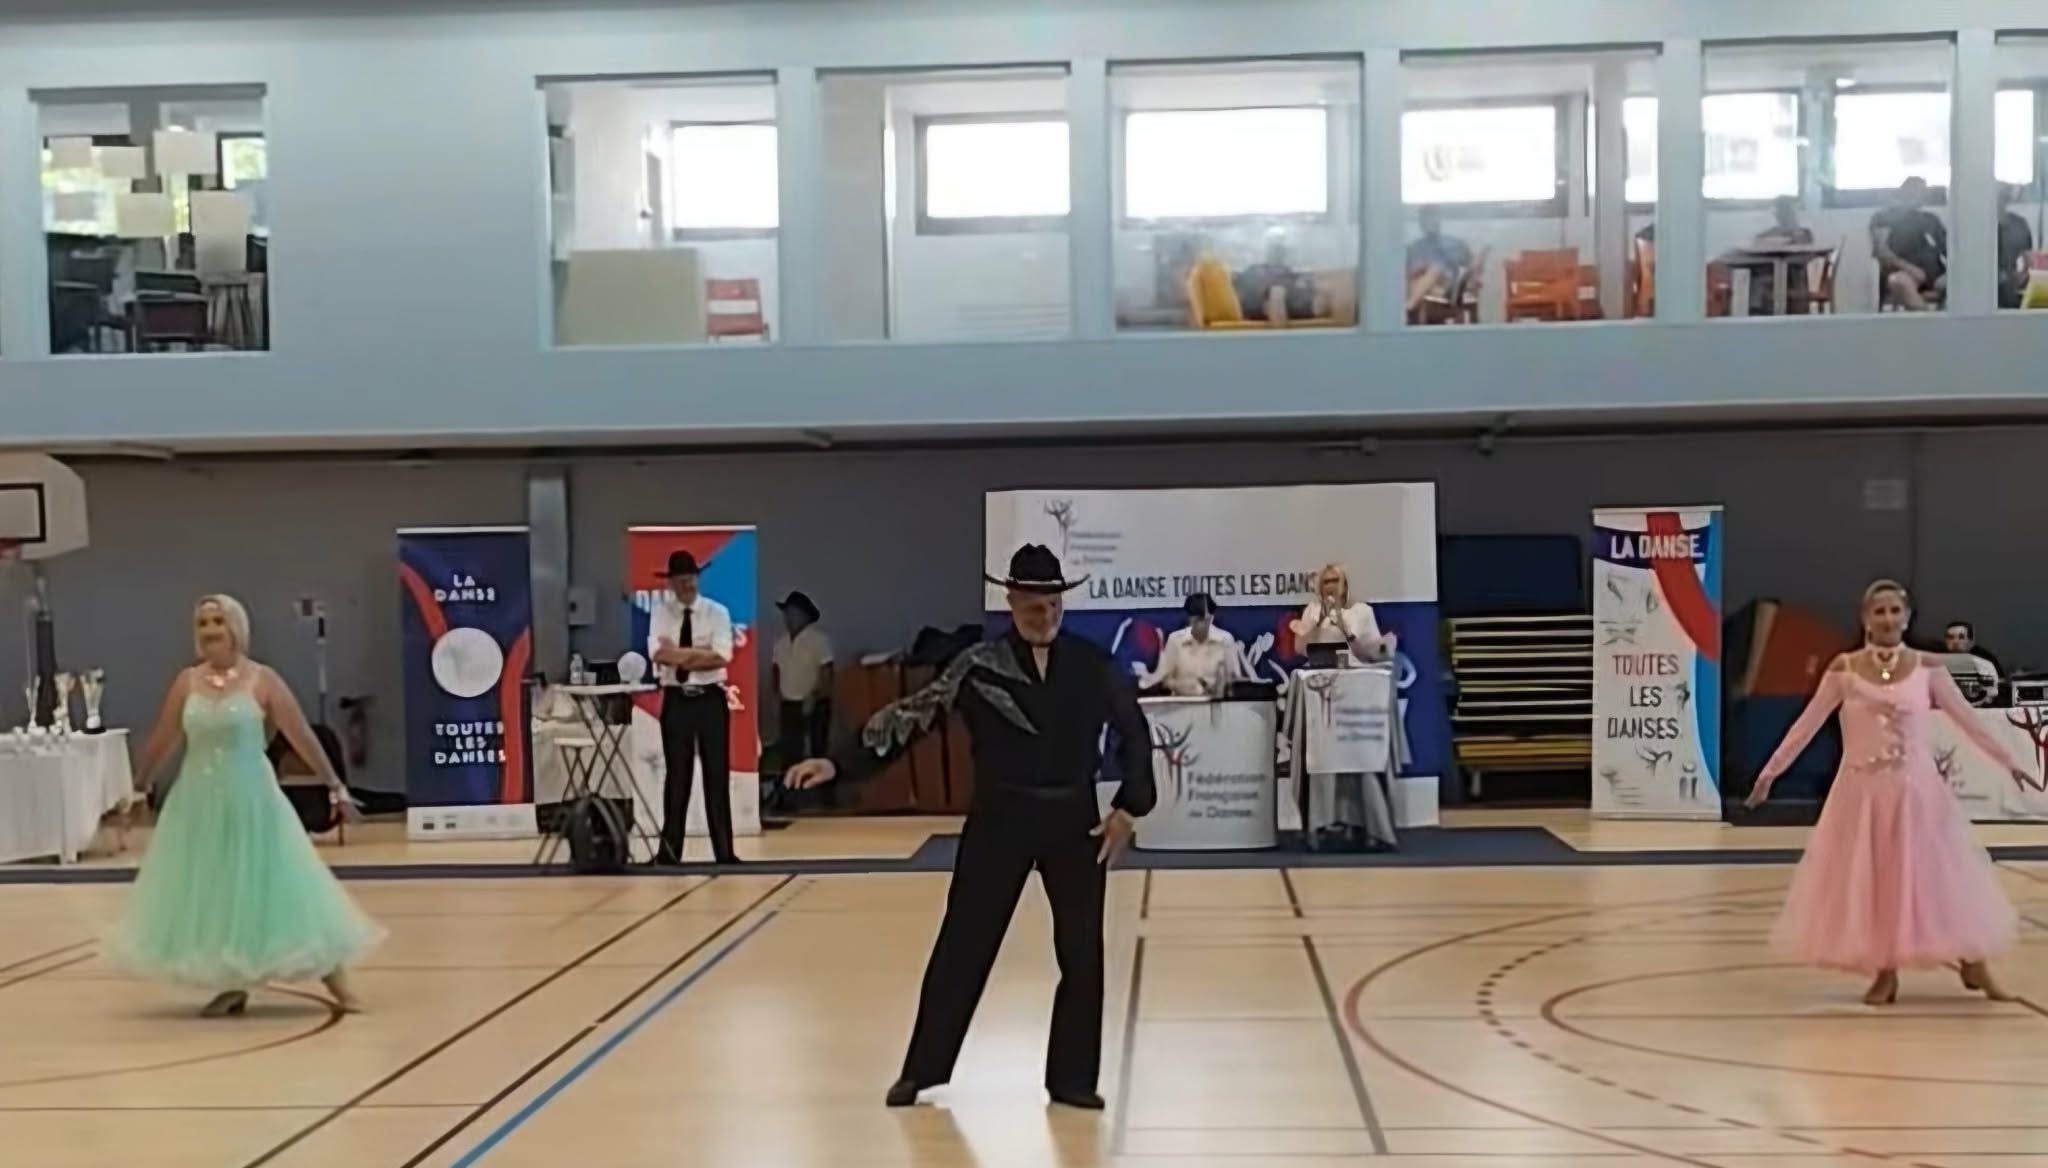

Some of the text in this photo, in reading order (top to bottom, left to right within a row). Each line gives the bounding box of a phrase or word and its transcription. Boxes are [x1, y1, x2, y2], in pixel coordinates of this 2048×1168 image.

[1609, 534, 1635, 559] LA
[453, 573, 476, 588] LA
[1090, 578, 1109, 599] LA
[1113, 576, 1167, 598] DANSE
[1173, 574, 1236, 598] TOUTES
[1241, 574, 1271, 596] LES
[1612, 653, 1679, 676] TOUTES
[1630, 685, 1663, 708] LES
